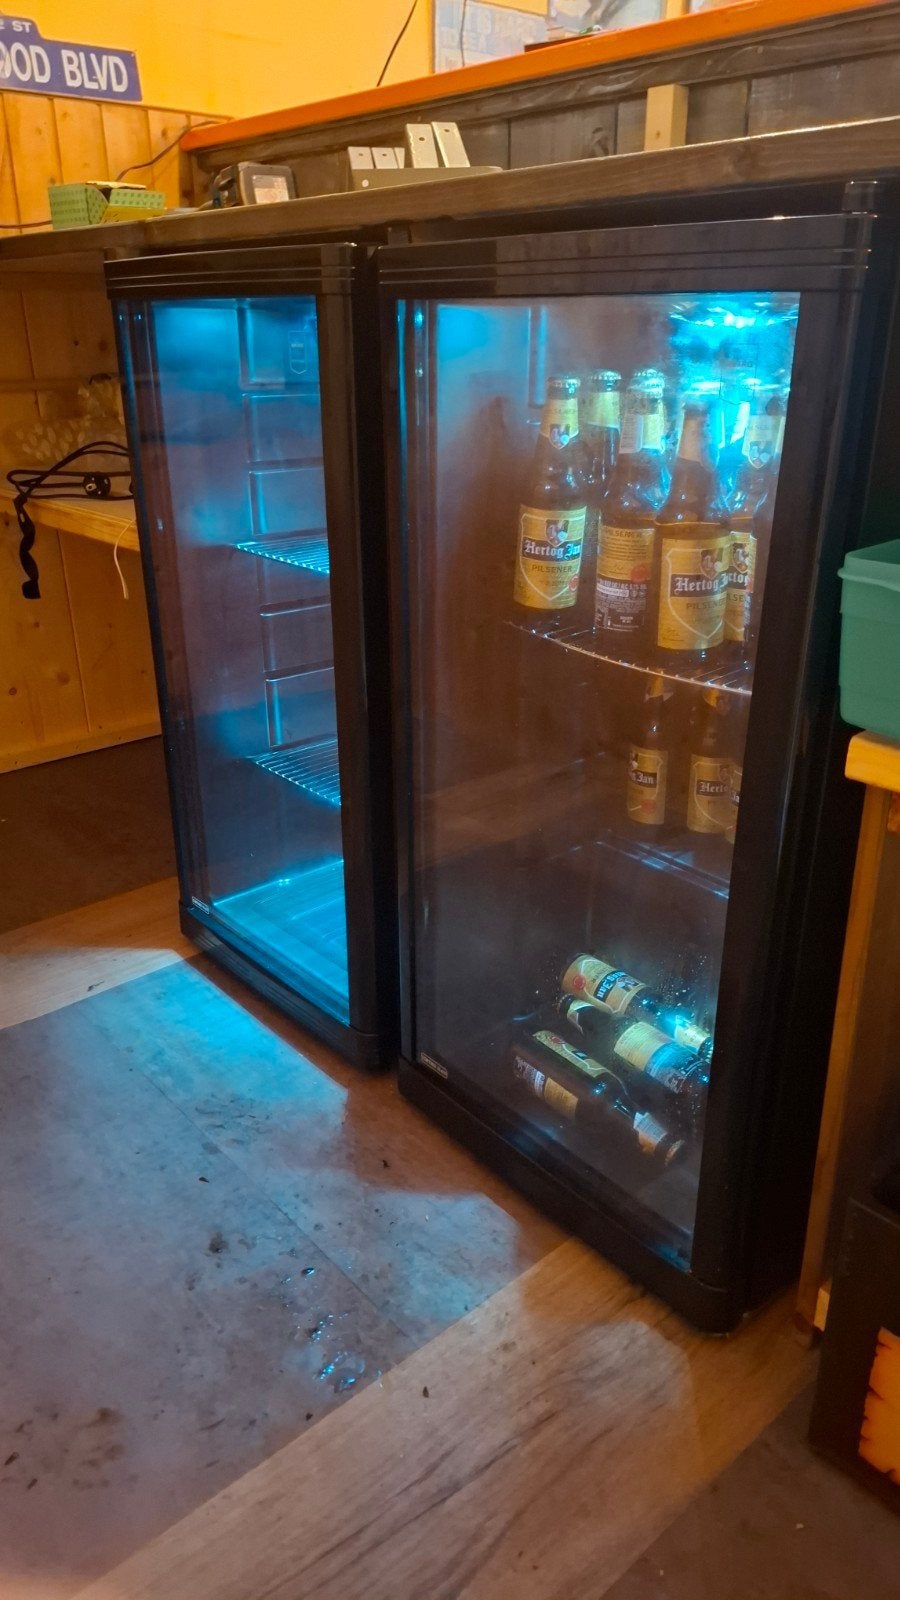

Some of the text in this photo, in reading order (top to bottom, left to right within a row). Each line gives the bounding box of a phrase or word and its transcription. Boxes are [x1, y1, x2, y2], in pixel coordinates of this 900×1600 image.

[12, 20, 32, 33] ST
[61, 49, 128, 92] BLVD
[524, 540, 564, 559] Hertog
[531, 564, 573, 574] PILSENER
[674, 576, 720, 595] Hertog
[636, 771, 655, 785] Jan
